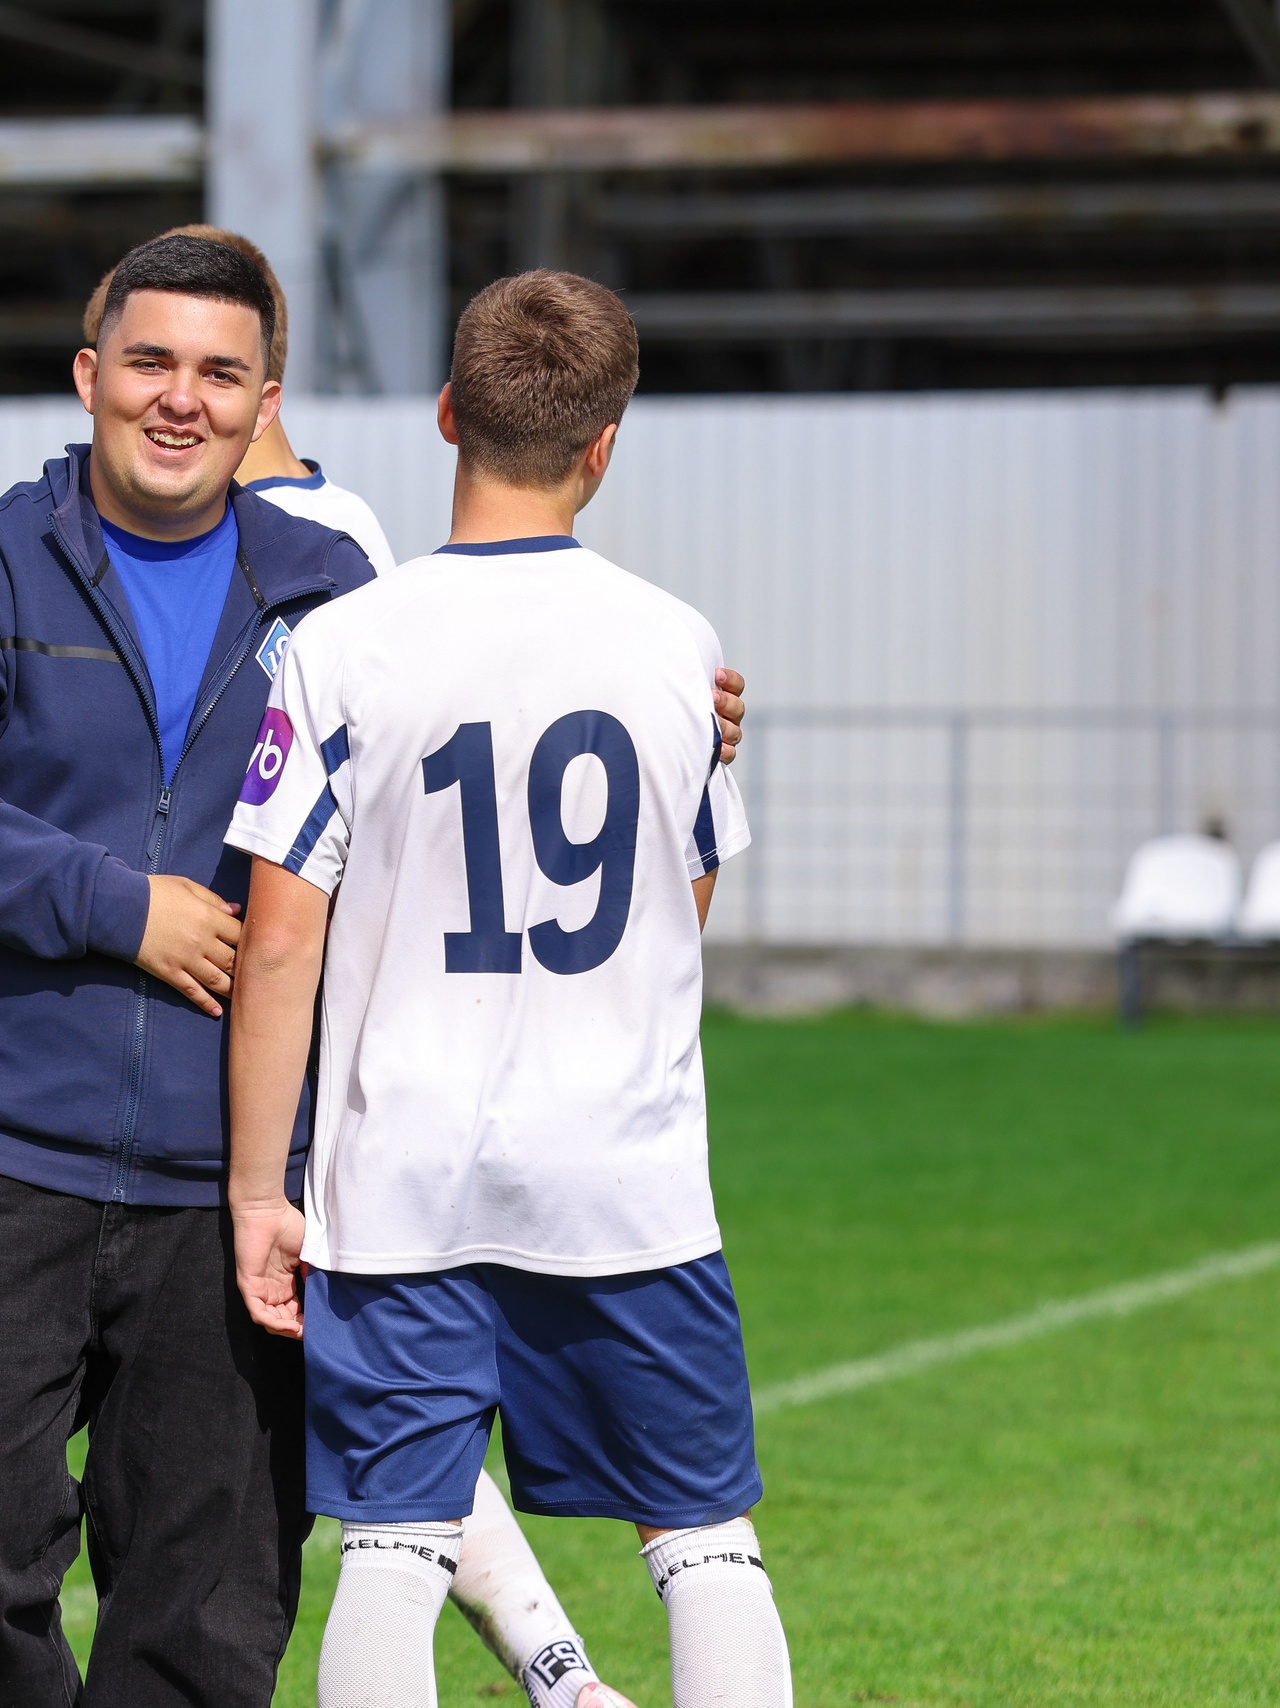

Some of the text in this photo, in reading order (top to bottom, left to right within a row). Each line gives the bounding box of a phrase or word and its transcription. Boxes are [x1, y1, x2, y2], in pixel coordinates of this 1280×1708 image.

[421, 711, 640, 975] 19
[343, 1539, 435, 1561] KELME
[658, 1552, 745, 1590] KELME
[533, 1642, 584, 1685] FS
